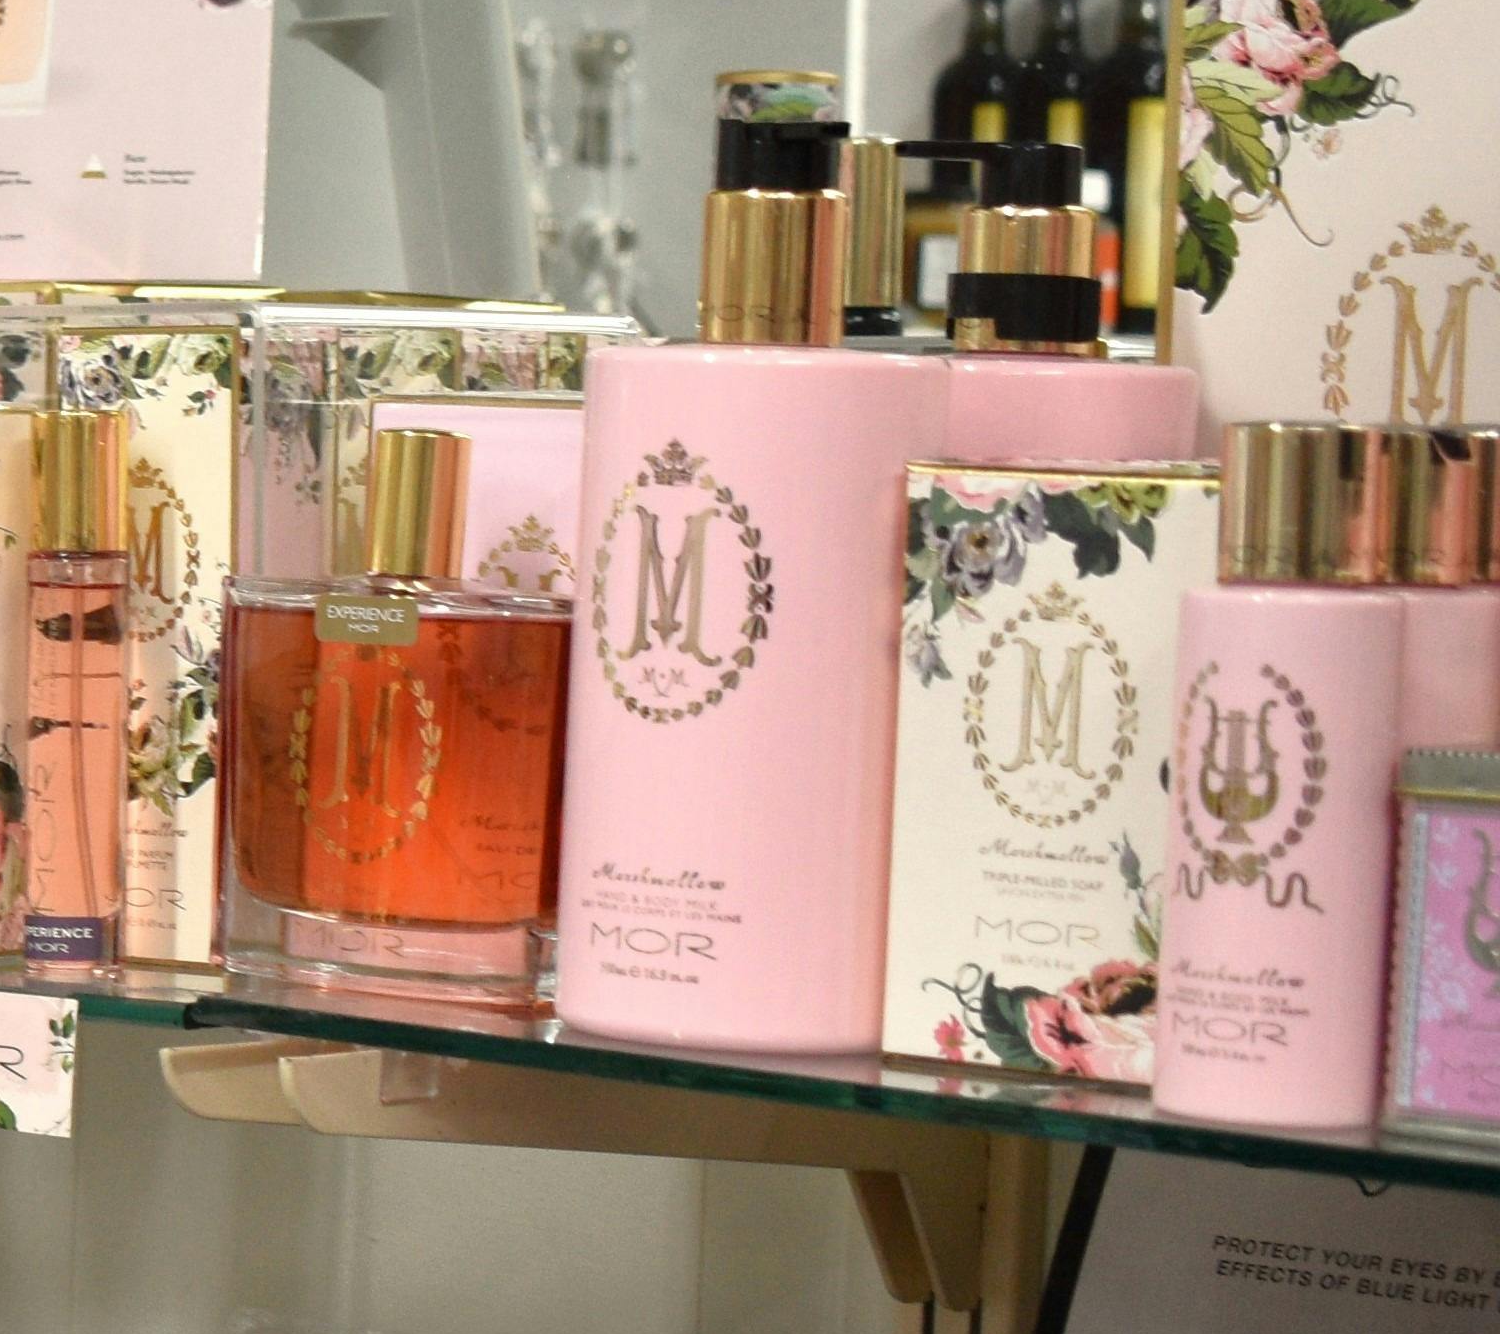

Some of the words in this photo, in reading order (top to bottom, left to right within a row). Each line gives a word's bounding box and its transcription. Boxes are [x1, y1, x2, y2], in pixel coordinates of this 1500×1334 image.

[325, 604, 406, 625] EXPERIENCE
[347, 622, 380, 635] MOR
[977, 837, 1109, 865] Marshmallow
[591, 861, 728, 893] Marshmallow
[590, 922, 718, 961] MOR
[974, 914, 1104, 951] MOR
[1172, 1012, 1289, 1048] MOR
[1212, 1235, 1314, 1263] PROTECT
[1322, 1249, 1382, 1270] YOUR
[1390, 1257, 1447, 1280] EYES
[1454, 1267, 1486, 1285] BY
[1216, 1259, 1312, 1287] EFFECTS
[1319, 1274, 1352, 1291] OF
[1356, 1277, 1416, 1301] BLUE
[1422, 1290, 1491, 1311] LIGHT
